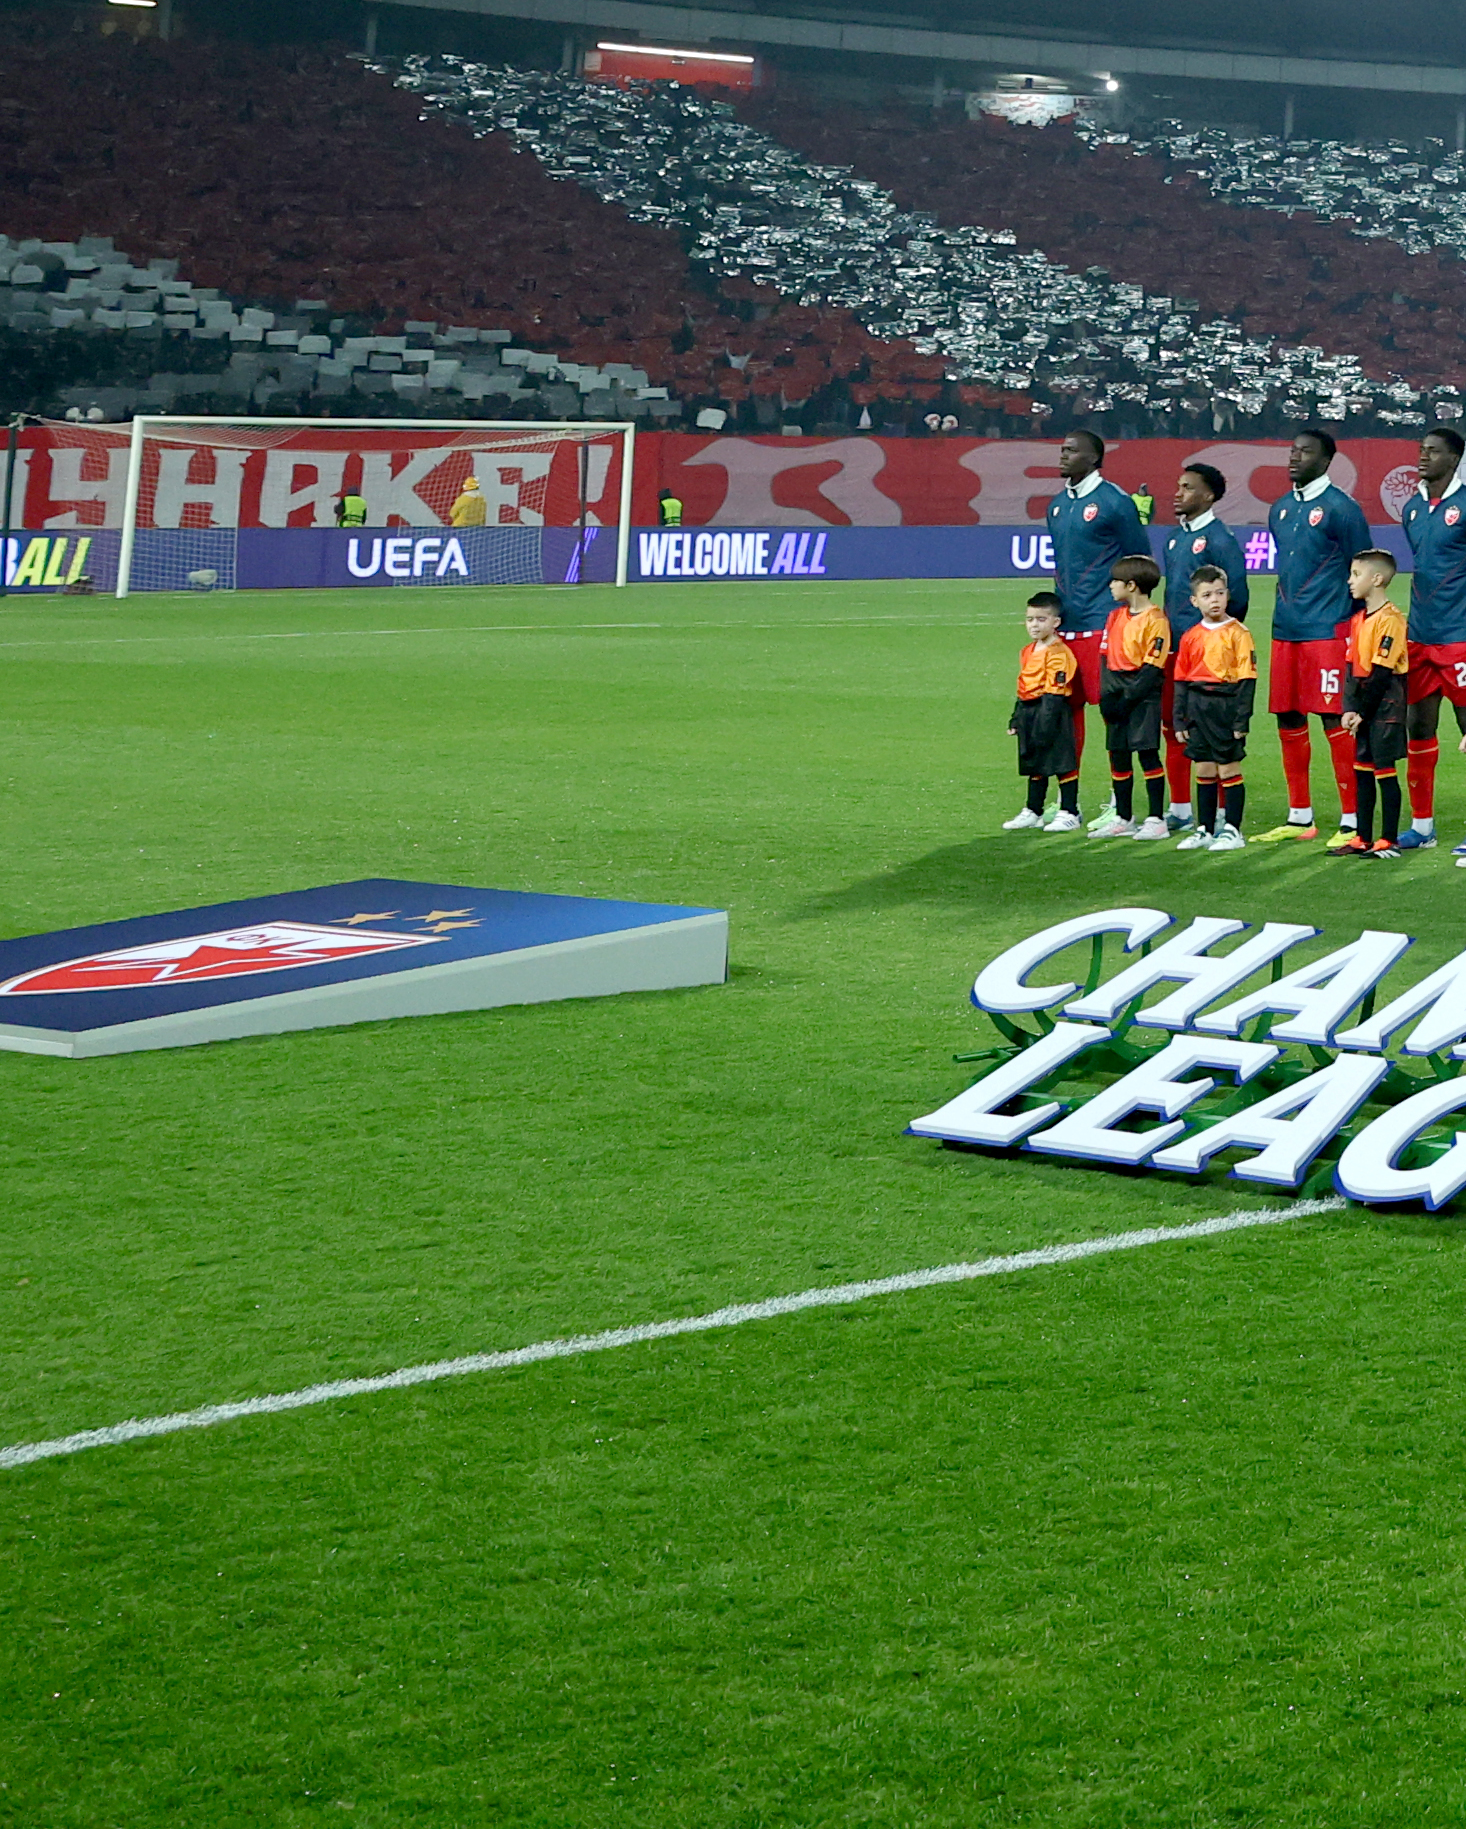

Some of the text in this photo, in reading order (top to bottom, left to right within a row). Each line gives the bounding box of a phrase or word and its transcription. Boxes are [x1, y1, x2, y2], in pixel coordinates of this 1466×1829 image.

[347, 536, 470, 578] UEFA
[639, 532, 828, 576] WELCOME ALL
[1320, 669, 1340, 694] 15
